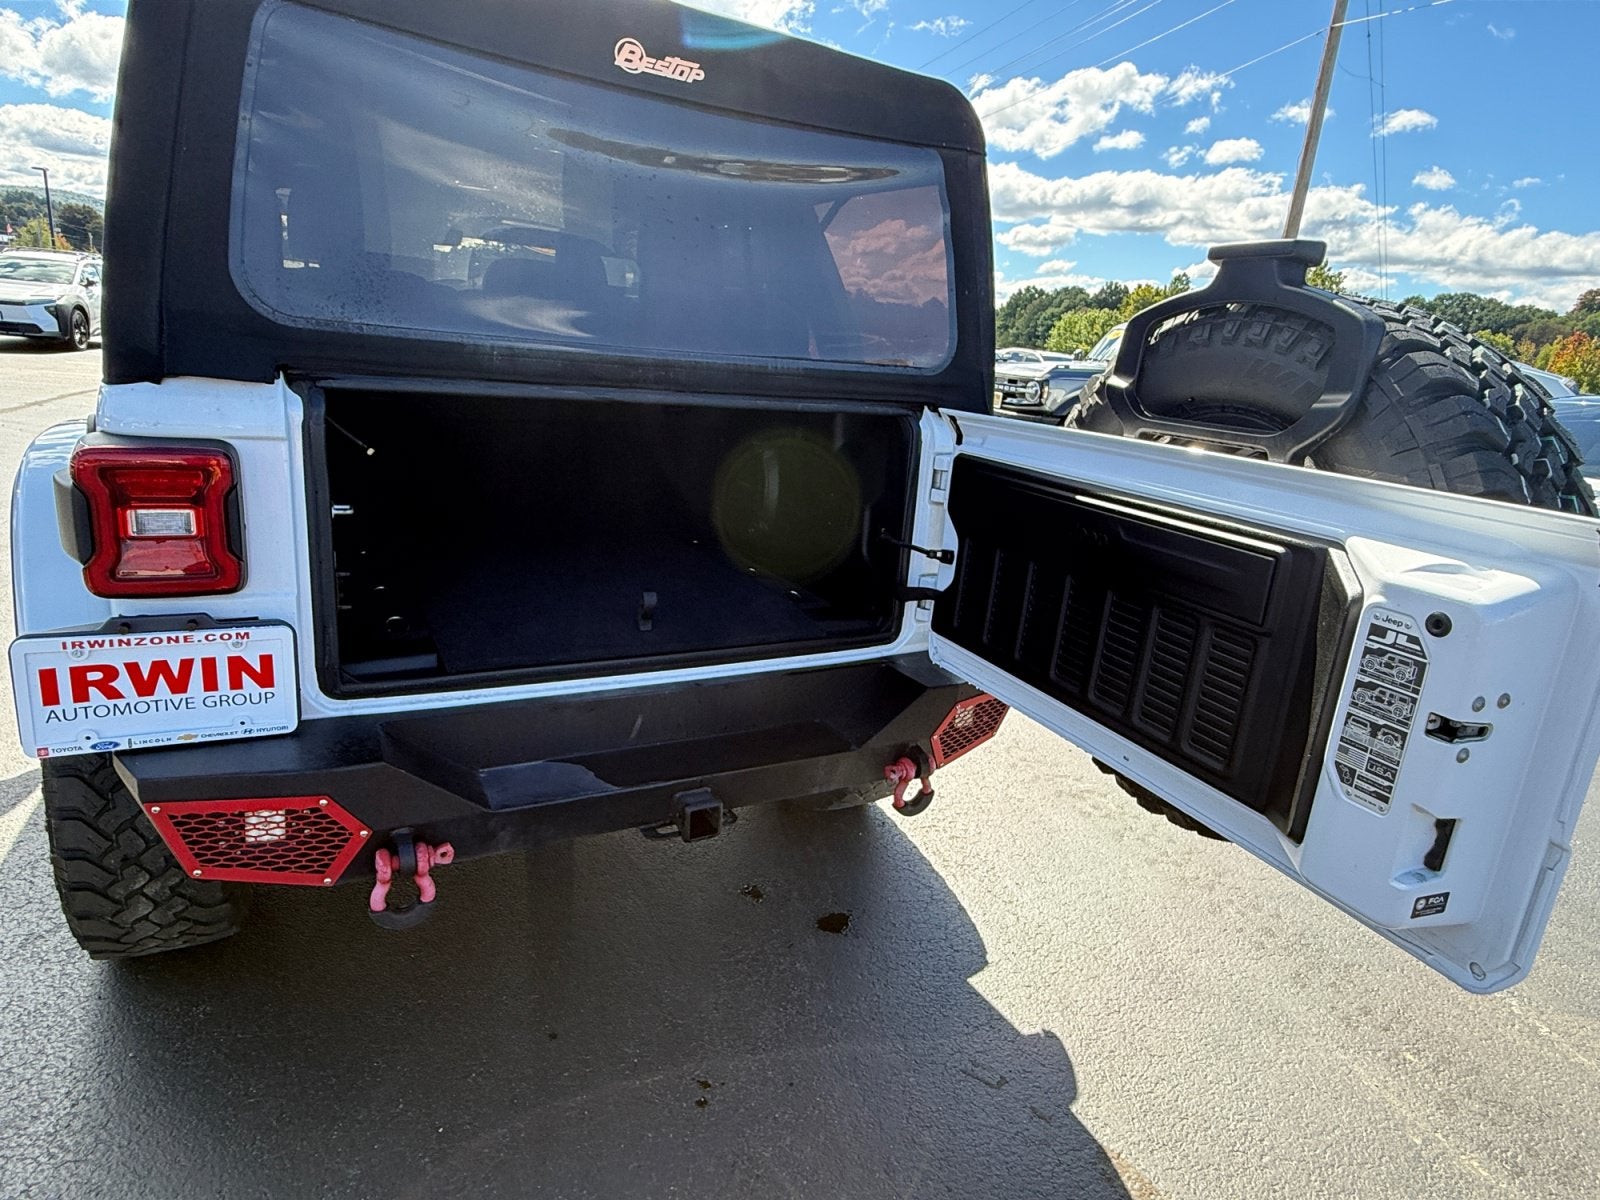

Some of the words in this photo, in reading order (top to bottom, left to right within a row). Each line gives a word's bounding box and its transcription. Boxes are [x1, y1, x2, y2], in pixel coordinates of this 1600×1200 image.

[1381, 615, 1404, 627] Jeep
[61, 631, 251, 651] IRWINZONE.COM
[1368, 630, 1421, 651] JL
[38, 653, 276, 707] IRWIN
[45, 696, 196, 724] AUTOMOTIVE
[202, 691, 276, 709] GROUP
[51, 746, 83, 754] TOYOTA
[133, 737, 172, 745] LINCOLN
[200, 730, 239, 739] CHEVROLET
[256, 725, 289, 733] HYUNDAI
